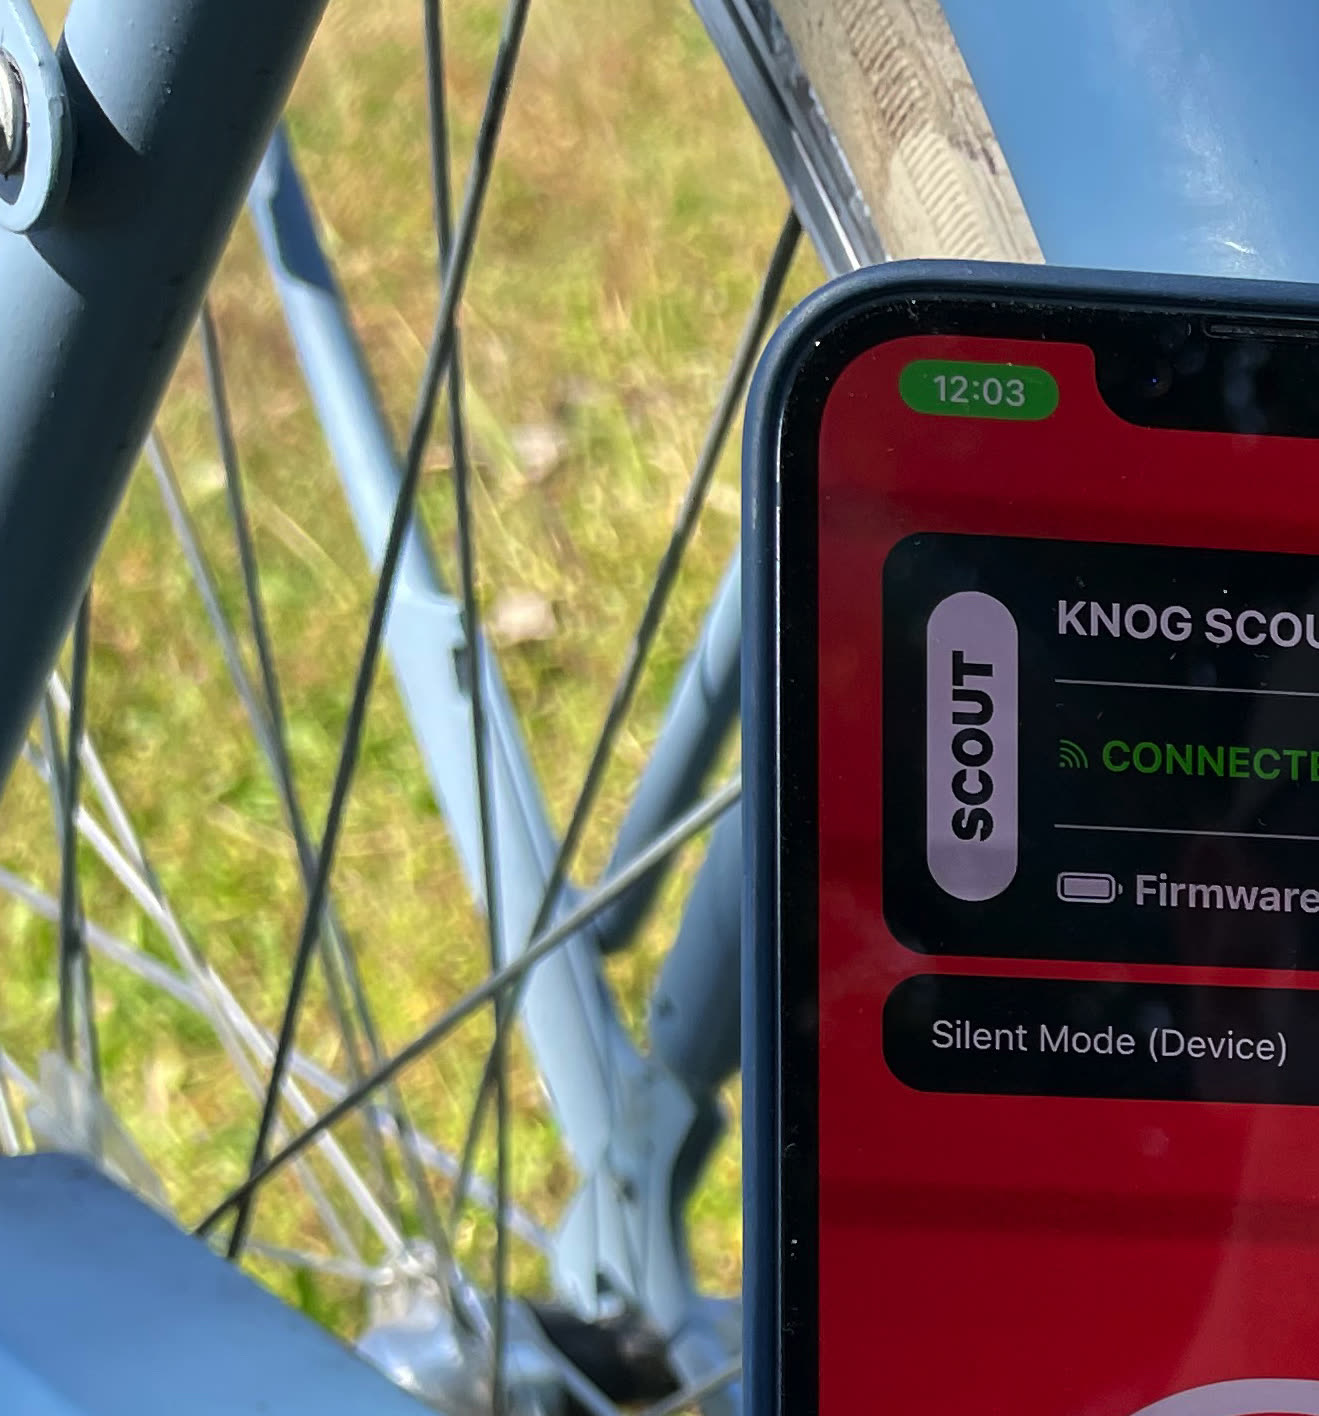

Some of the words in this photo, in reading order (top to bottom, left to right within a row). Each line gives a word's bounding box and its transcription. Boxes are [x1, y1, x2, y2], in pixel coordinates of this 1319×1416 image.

[932, 374, 1027, 408] 12:03
[1056, 600, 1193, 643] KNOG
[951, 650, 995, 842] SCOUT
[930, 1018, 1029, 1053] Silent
[1038, 1022, 1136, 1058] Mode
[1147, 1025, 1288, 1068] (Device)
